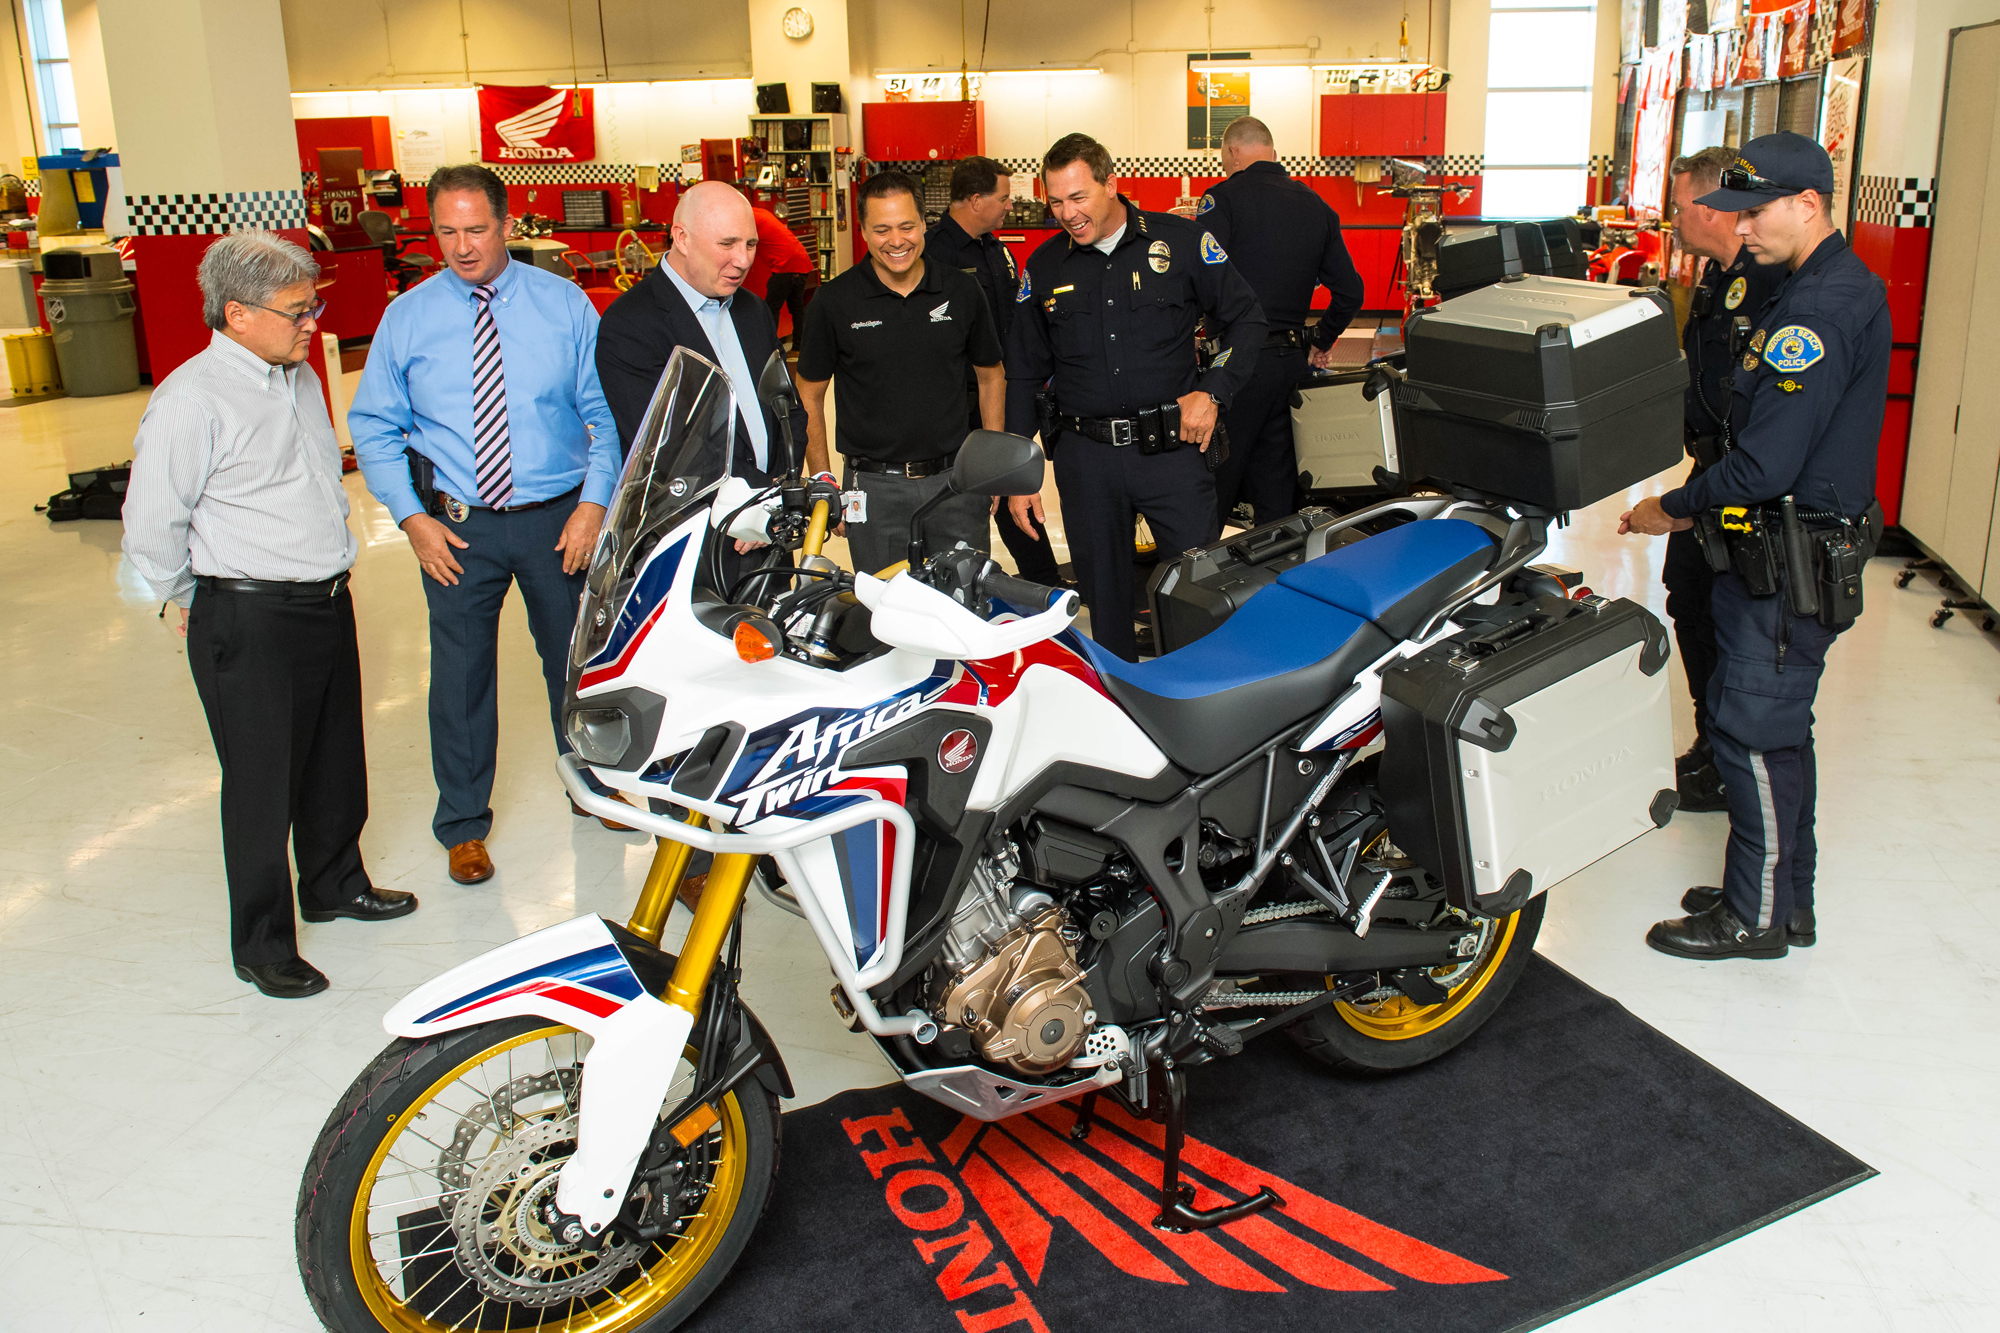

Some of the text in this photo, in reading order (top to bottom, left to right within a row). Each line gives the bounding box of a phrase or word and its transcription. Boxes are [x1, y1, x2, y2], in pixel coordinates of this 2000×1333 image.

[890, 79, 906, 90] 51
[498, 146, 574, 160] HONDA
[1740, 158, 1757, 176] BEACH
[334, 206, 350, 221] 14
[930, 315, 953, 323] HONDA
[1768, 328, 1796, 353] REDONDO
[1797, 328, 1821, 352] BEACH
[1777, 358, 1808, 367] POLICE
[748, 690, 948, 789] Africa
[945, 753, 974, 768] HONDA
[1539, 745, 1635, 805] HONDA
[728, 757, 850, 827] Twin
